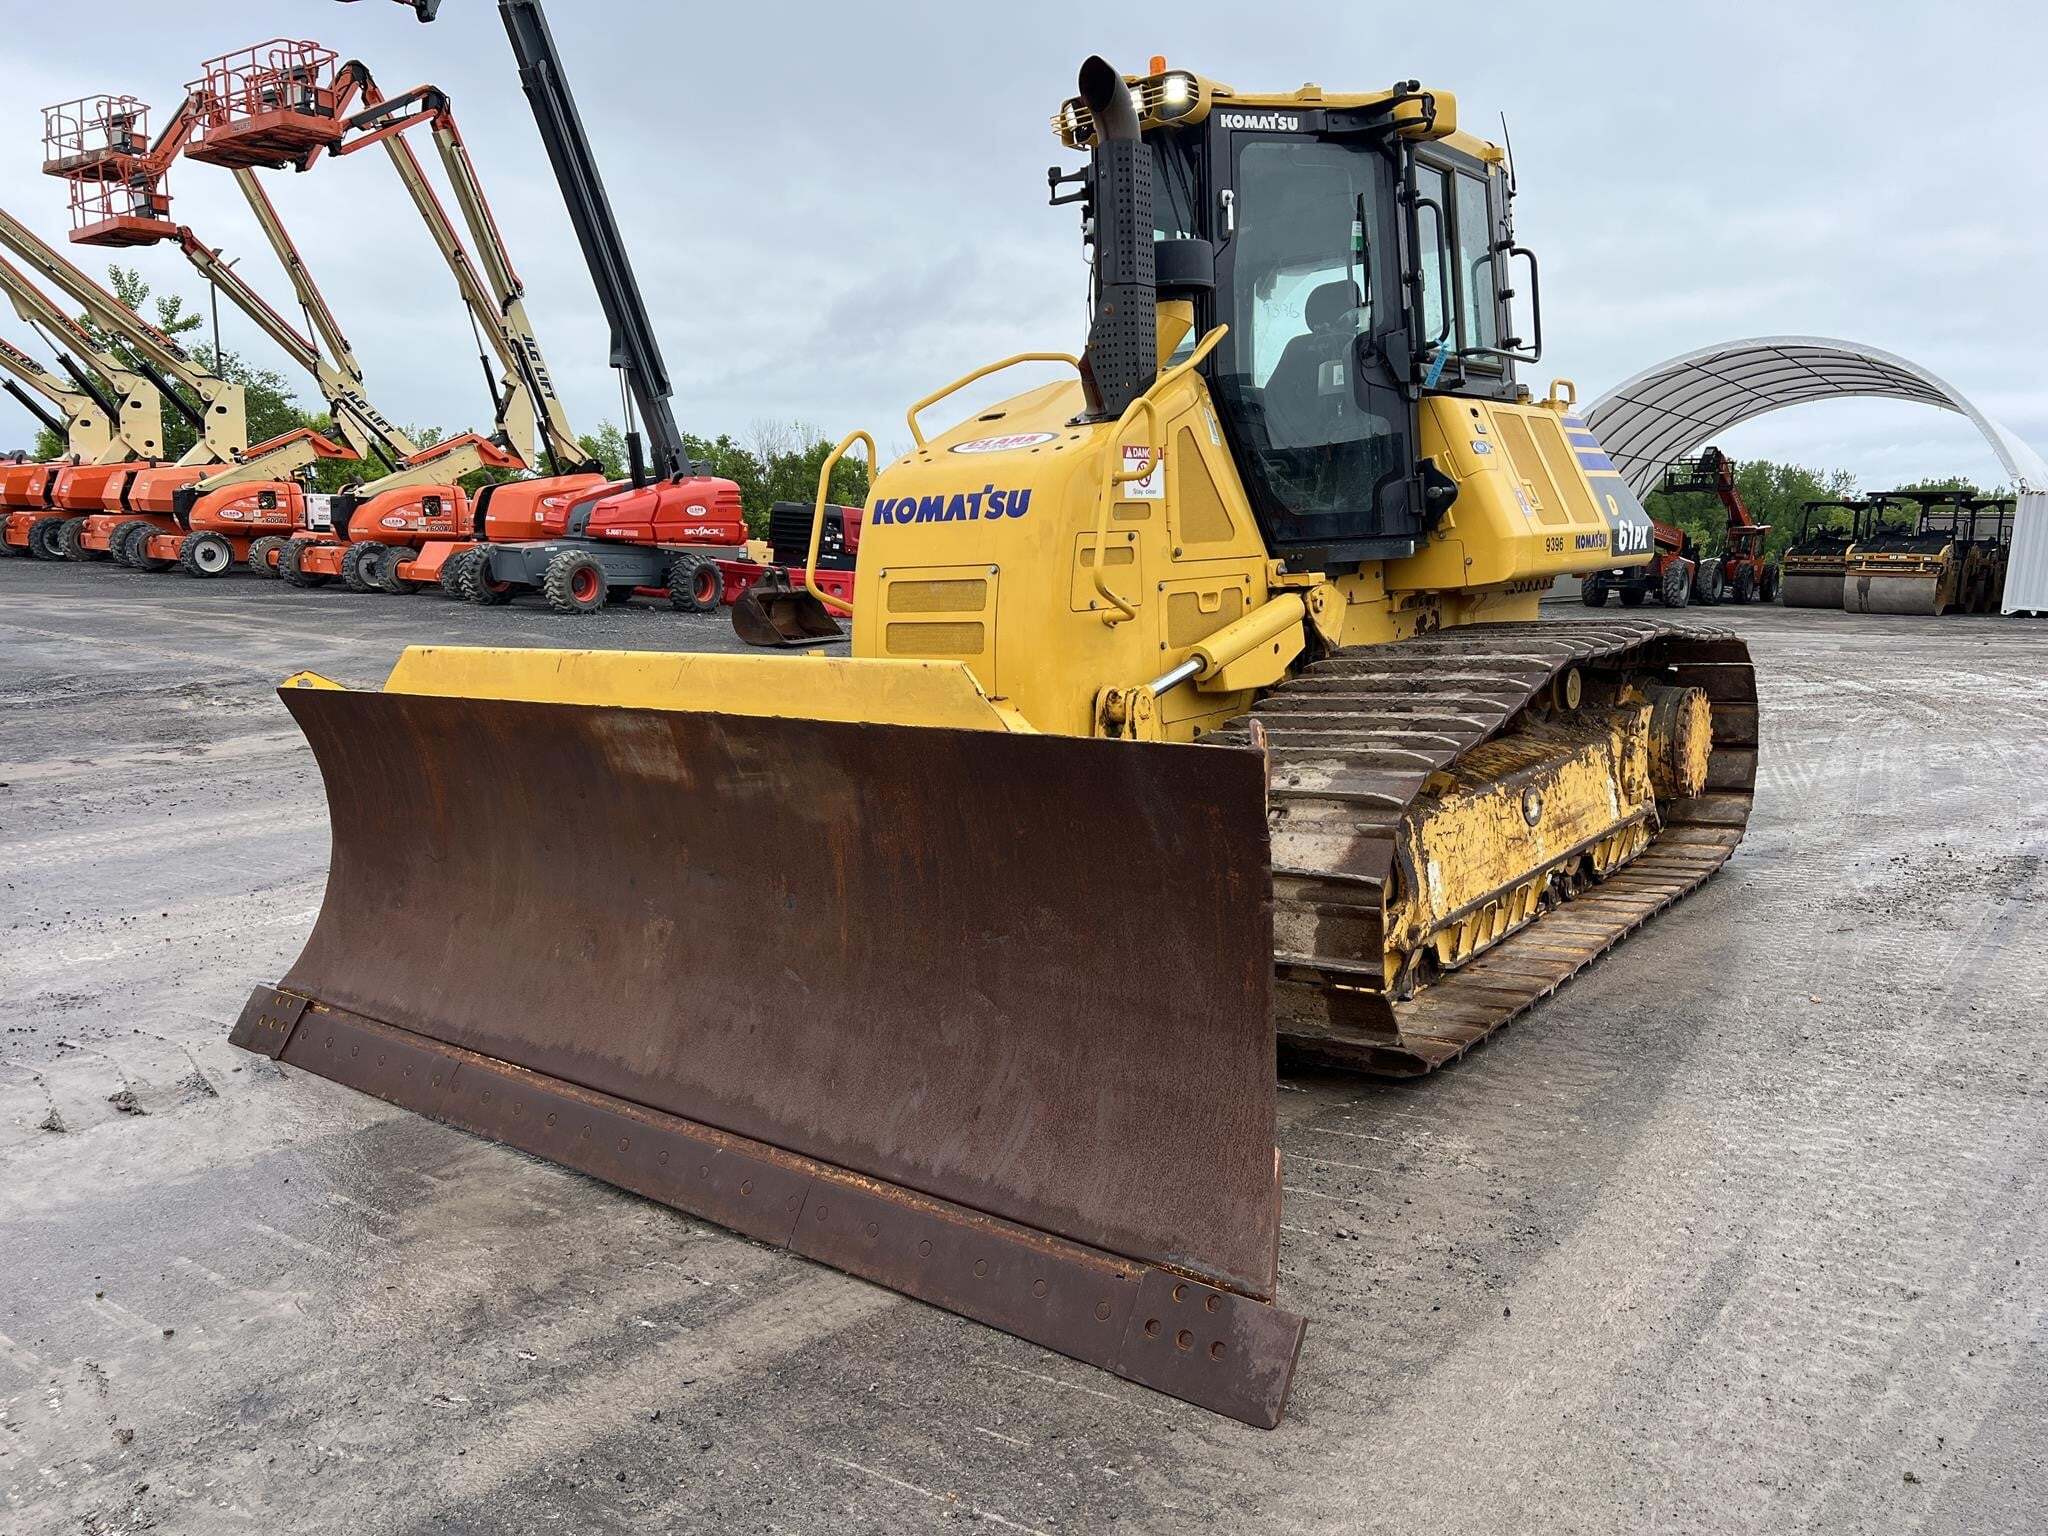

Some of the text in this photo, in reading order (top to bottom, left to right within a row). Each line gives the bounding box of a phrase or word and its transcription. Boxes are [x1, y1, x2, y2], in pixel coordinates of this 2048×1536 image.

[1219, 113, 1299, 131] KOMATSU
[521, 334, 556, 400] JLG LIFT
[344, 390, 395, 434] JLG LIFT
[871, 484, 1032, 525] KOMATSU
[1605, 494, 1619, 516] D
[683, 526, 719, 536] SKYJACK
[1545, 530, 1608, 552] 9396 KOMATSU
[1618, 520, 1649, 552] 61PX
